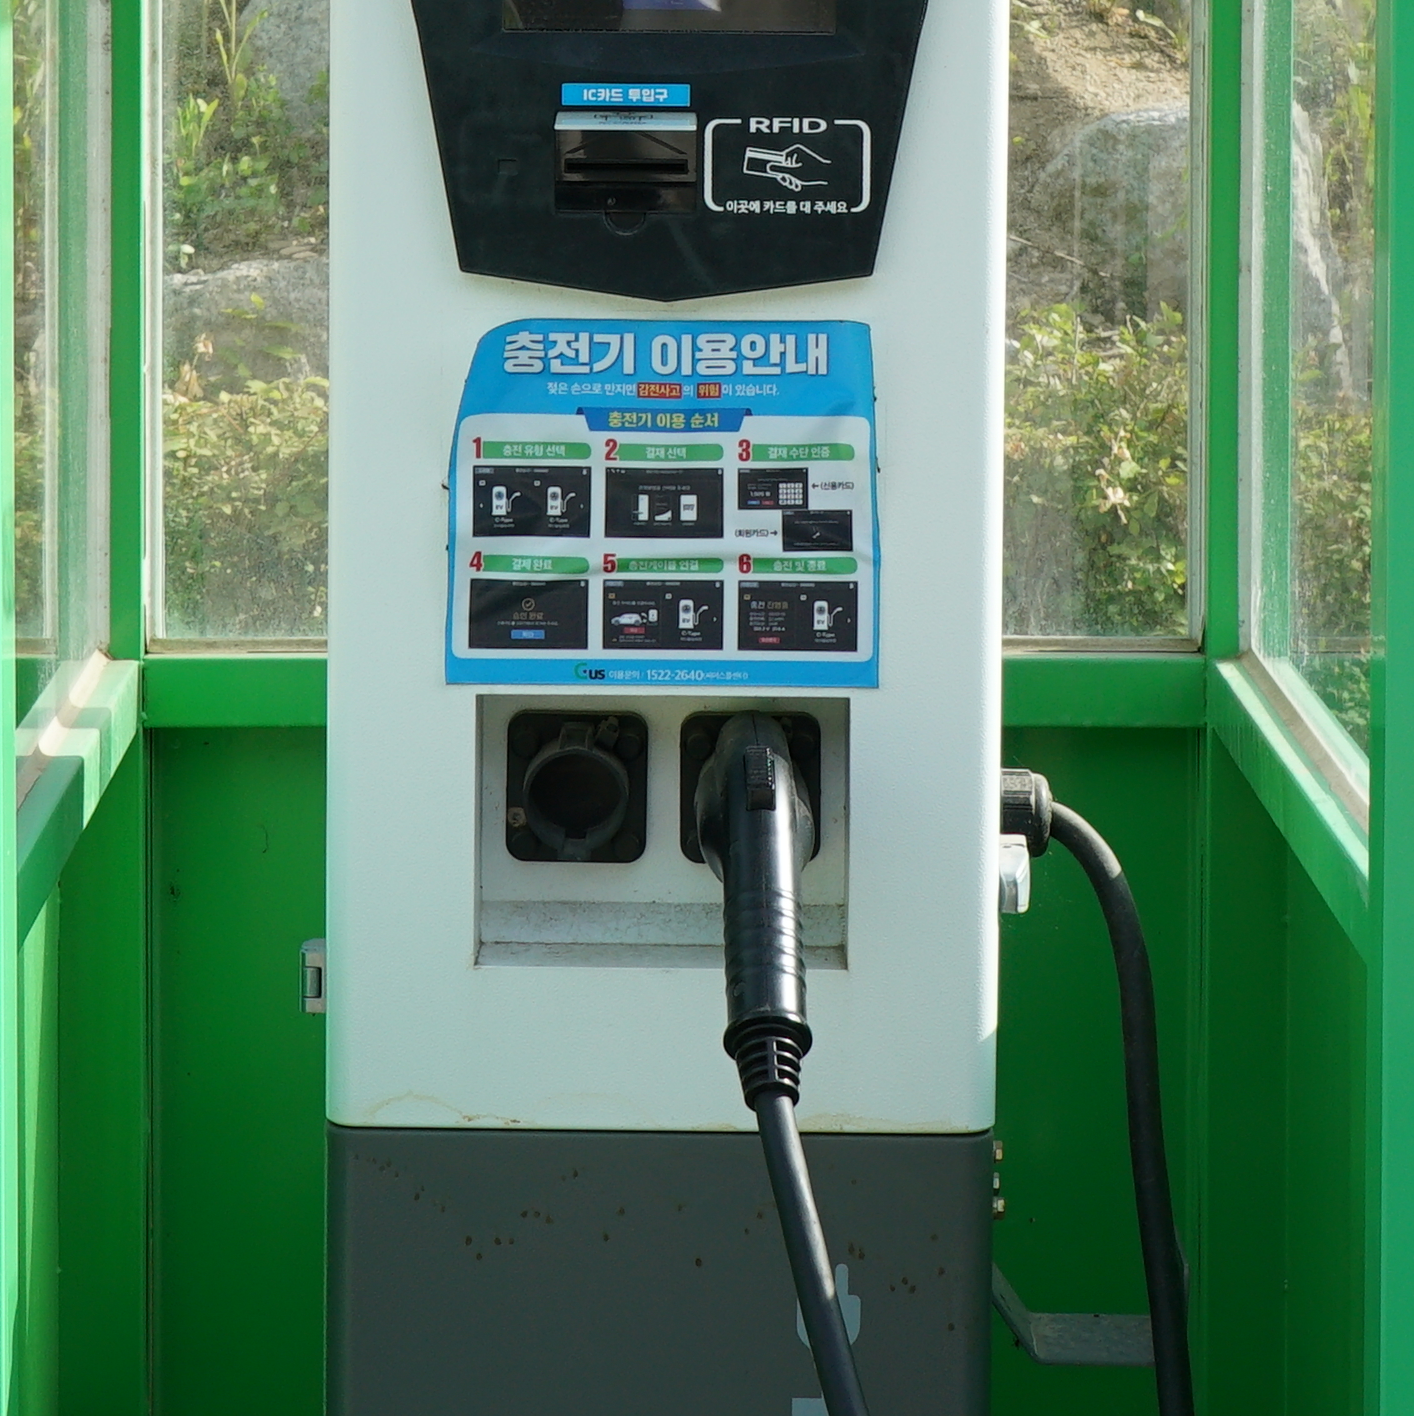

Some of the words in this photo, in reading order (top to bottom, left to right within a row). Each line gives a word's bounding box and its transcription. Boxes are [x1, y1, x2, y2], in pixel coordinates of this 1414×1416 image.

[583, 88, 624, 102] IC카드
[628, 88, 669, 103] 투입구
[749, 117, 827, 134] RFID
[725, 199, 761, 214] 이곳에
[762, 199, 798, 214] 카드를
[799, 199, 811, 214] 대
[813, 199, 849, 214] 주세요
[502, 330, 635, 376] 충전기
[650, 332, 828, 377] 이용안내
[546, 382, 568, 396] 젖은
[570, 382, 602, 396] 손으로
[604, 382, 636, 396] 만지면
[735, 383, 780, 397] 있습니다.
[607, 411, 652, 429] 충전기
[656, 411, 686, 429] 이용
[690, 411, 720, 429] 순서
[472, 436, 482, 459] 1
[502, 444, 522, 457] 충전
[524, 444, 544, 457] 유형
[545, 444, 566, 457] 선택
[604, 438, 618, 461] 2
[666, 447, 687, 459] 선택
[738, 438, 751, 462] 3
[788, 447, 809, 459] 수단
[811, 446, 830, 459] 인증
[469, 550, 483, 572] 4
[532, 558, 553, 571] 완료
[602, 553, 616, 573] 5
[738, 553, 752, 574] 6
